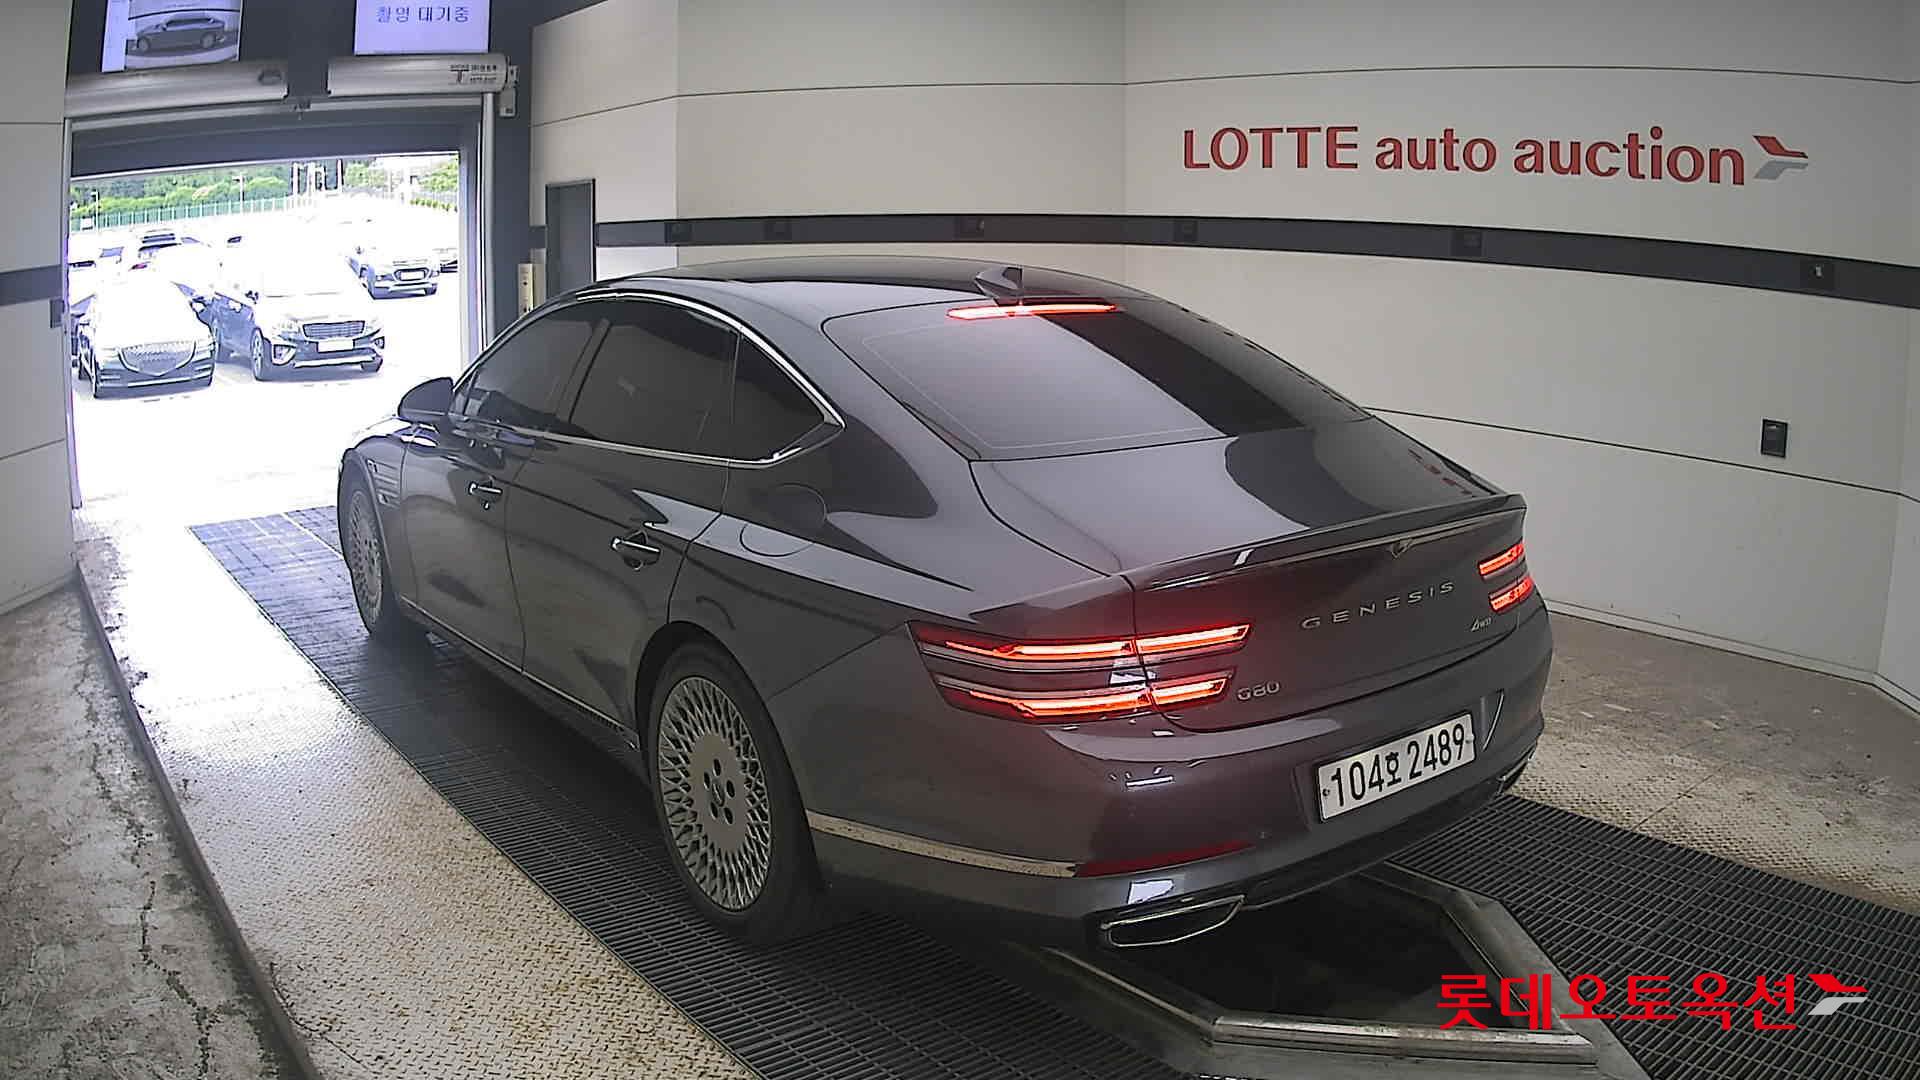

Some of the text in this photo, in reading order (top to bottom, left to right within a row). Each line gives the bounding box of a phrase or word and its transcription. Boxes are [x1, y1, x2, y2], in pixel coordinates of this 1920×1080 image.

[418, 6, 469, 23] 대기중
[1183, 126, 1745, 186] LOTTE auto auction
[1301, 581, 1455, 630] GENESIS
[1237, 681, 1280, 701] G80
[1331, 723, 1465, 807] 104호 2489
